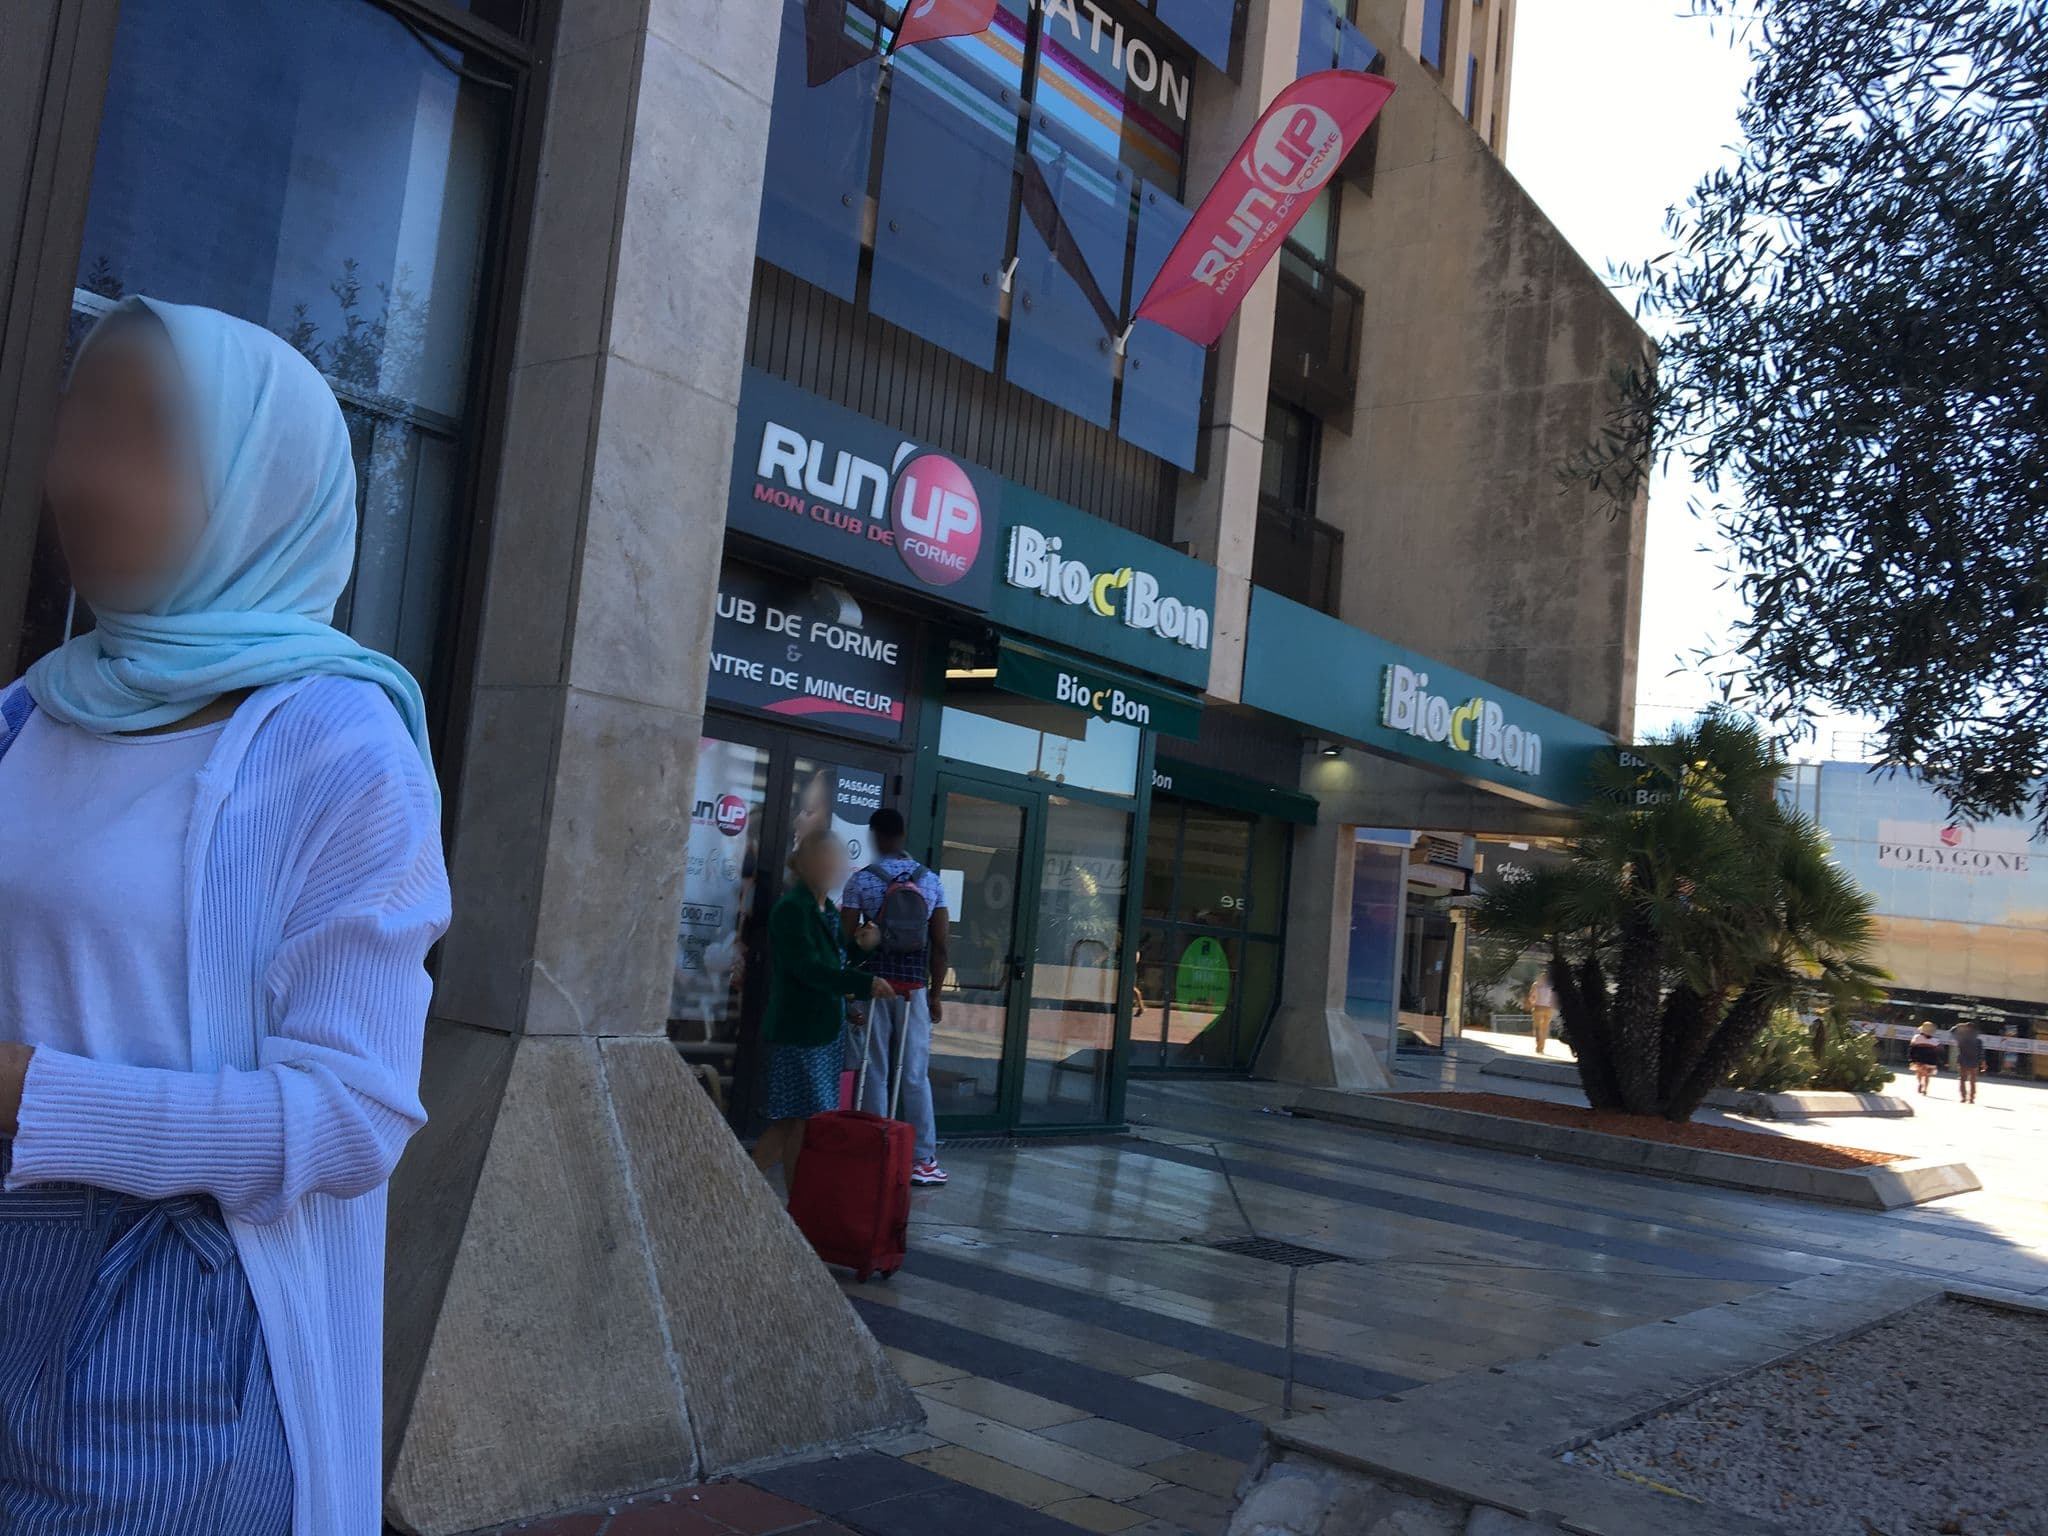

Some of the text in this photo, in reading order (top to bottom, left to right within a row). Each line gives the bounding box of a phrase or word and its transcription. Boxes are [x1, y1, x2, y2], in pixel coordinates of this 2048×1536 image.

[1029, 0, 1189, 121] ATION
[1216, 260, 1244, 295] MON
[1276, 194, 1296, 218] DE
[1297, 132, 1338, 189] FORME
[754, 483, 967, 571] MON CLUB DE FORME
[1007, 525, 1090, 605] Bio
[765, 607, 802, 638] DE
[810, 622, 898, 665] FORME
[786, 645, 803, 662] &
[770, 668, 799, 690] DE
[804, 676, 893, 714] MINCEUR
[1056, 673, 1091, 706] Bio
[1382, 664, 1451, 742] Bio
[837, 793, 881, 809] DE BADGE
[838, 778, 882, 795] PASSAGE
[1879, 844, 2030, 872] POLYGONE
